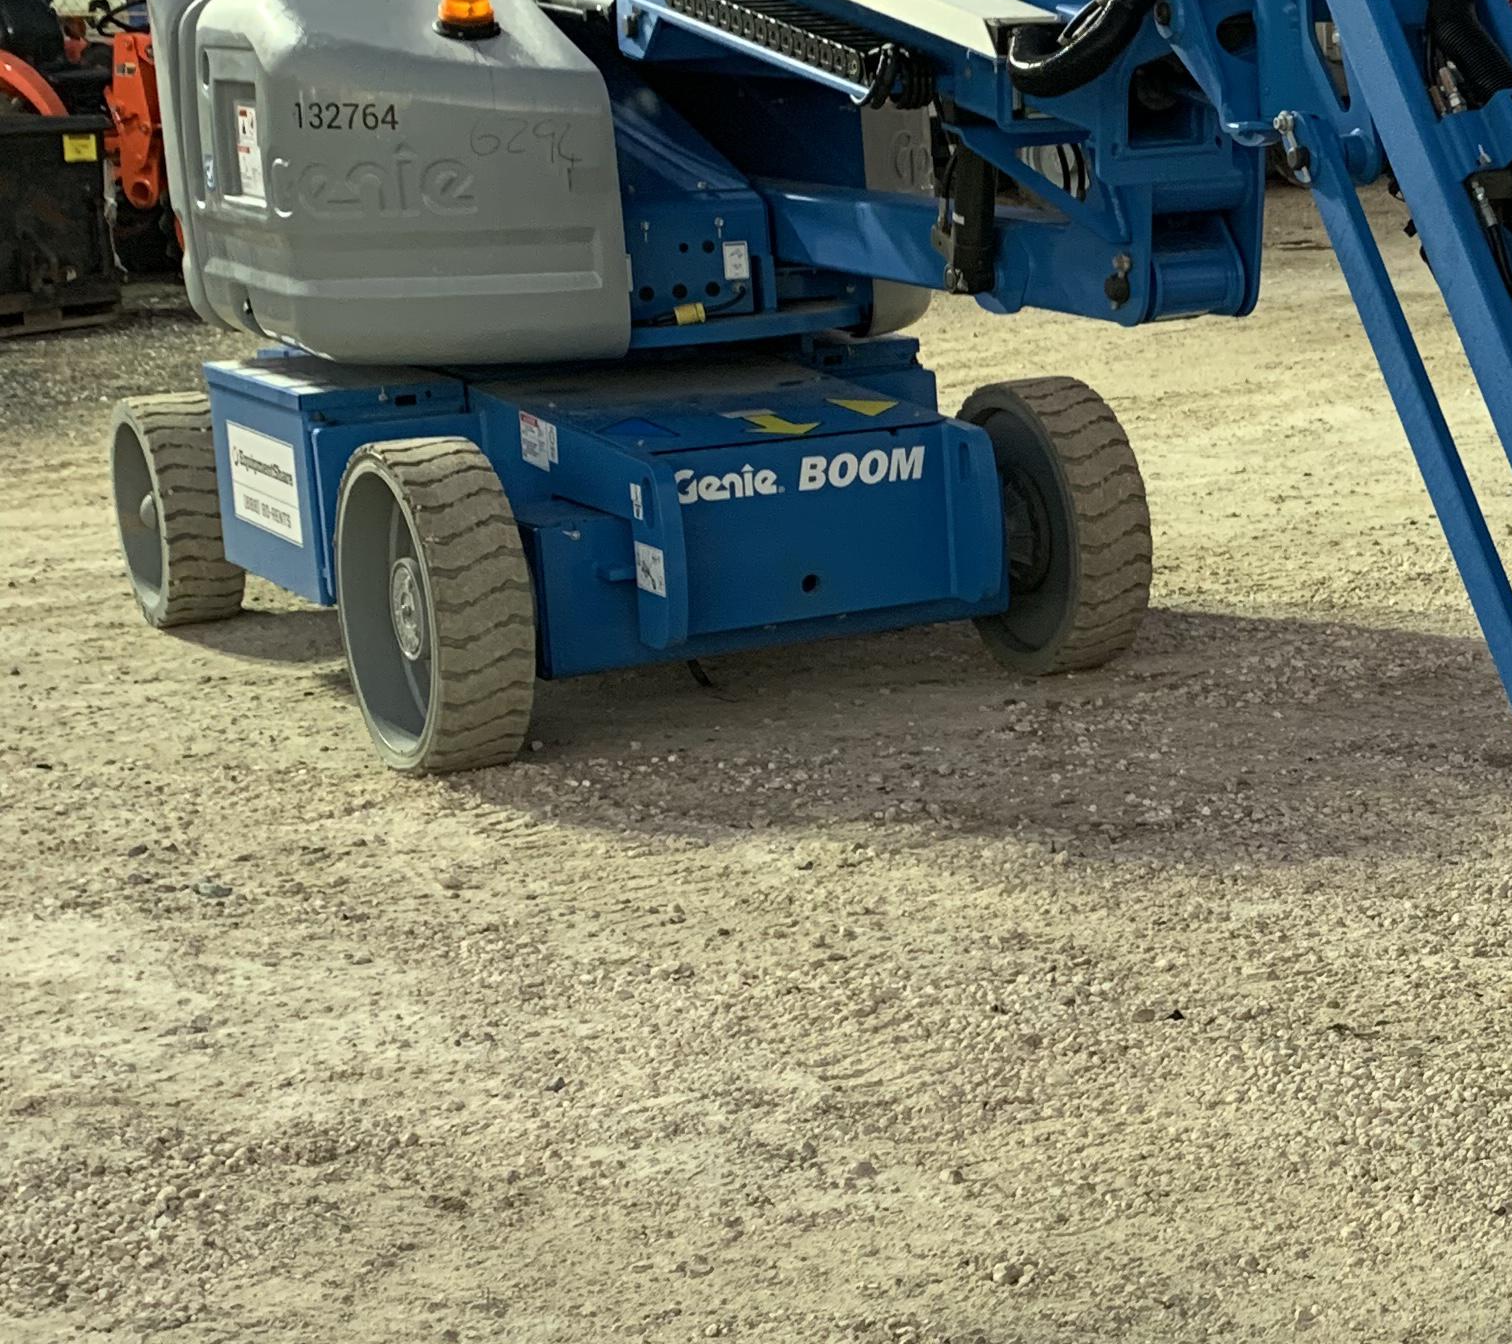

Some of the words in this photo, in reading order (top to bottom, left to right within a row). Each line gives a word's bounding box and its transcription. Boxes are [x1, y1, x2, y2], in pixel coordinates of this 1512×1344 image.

[294, 103, 399, 131] 132764
[674, 463, 778, 505] Genie
[798, 446, 926, 492] BOOM
